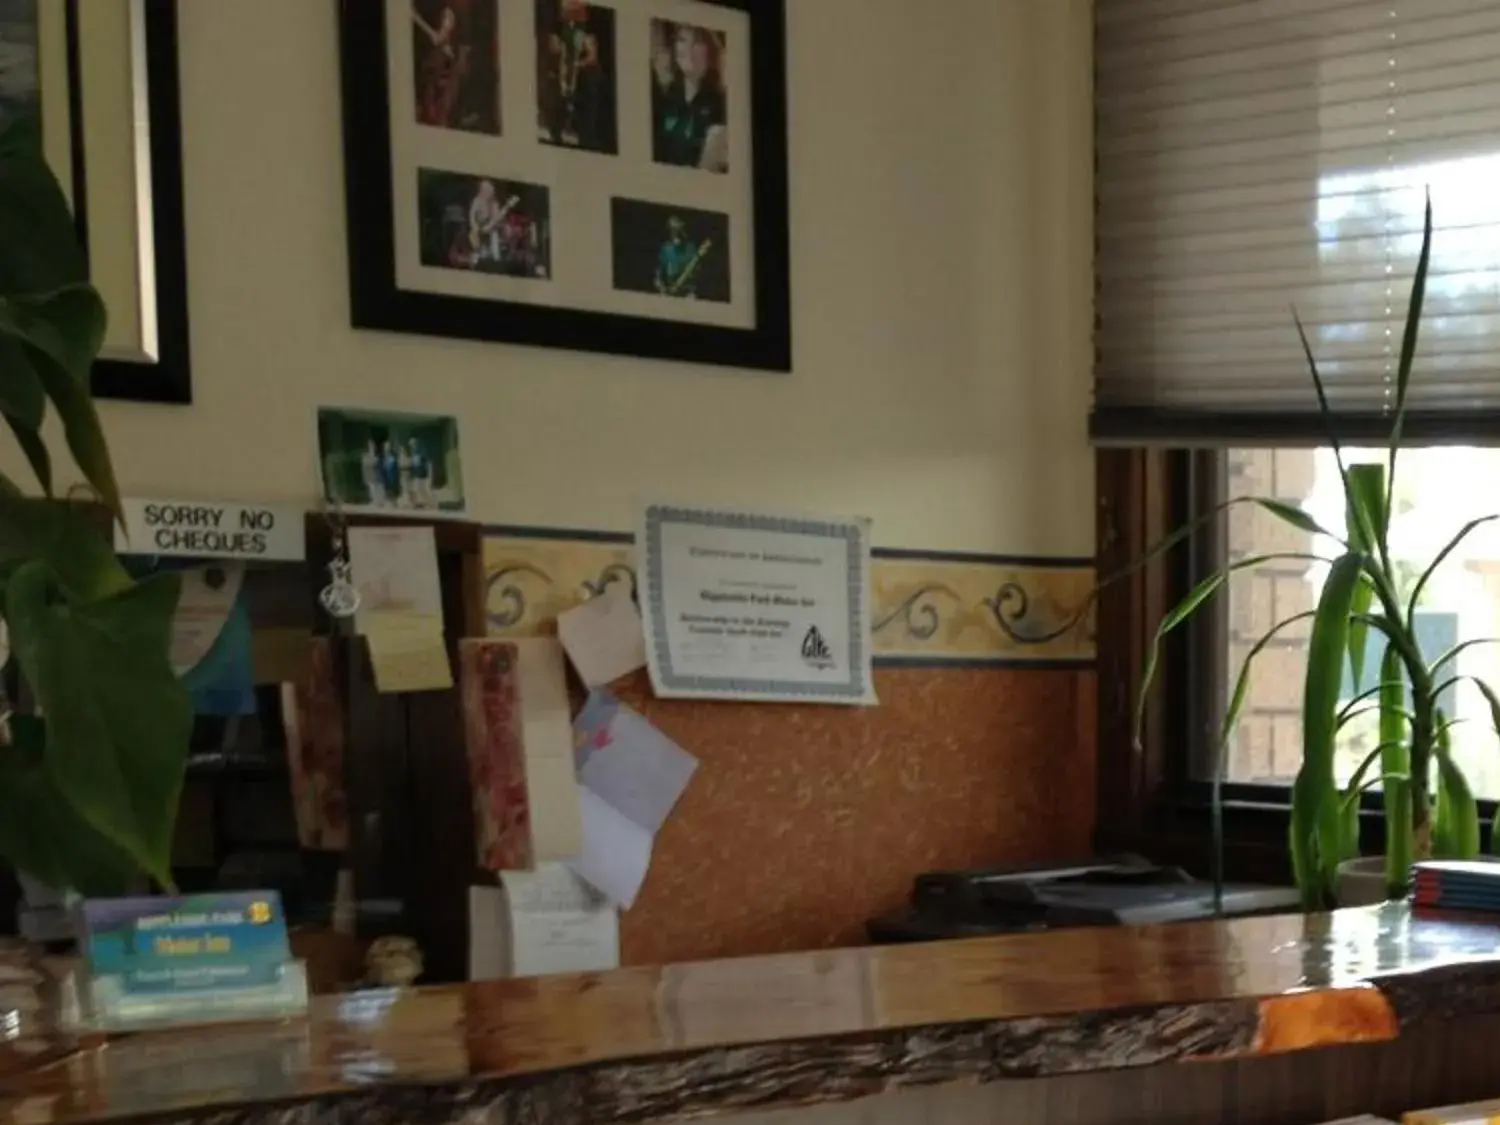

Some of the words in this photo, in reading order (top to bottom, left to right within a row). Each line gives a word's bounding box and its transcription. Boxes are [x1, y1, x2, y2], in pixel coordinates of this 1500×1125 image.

[144, 503, 224, 527] SORRY
[239, 508, 275, 531] NO
[154, 528, 267, 554] CHEQUES
